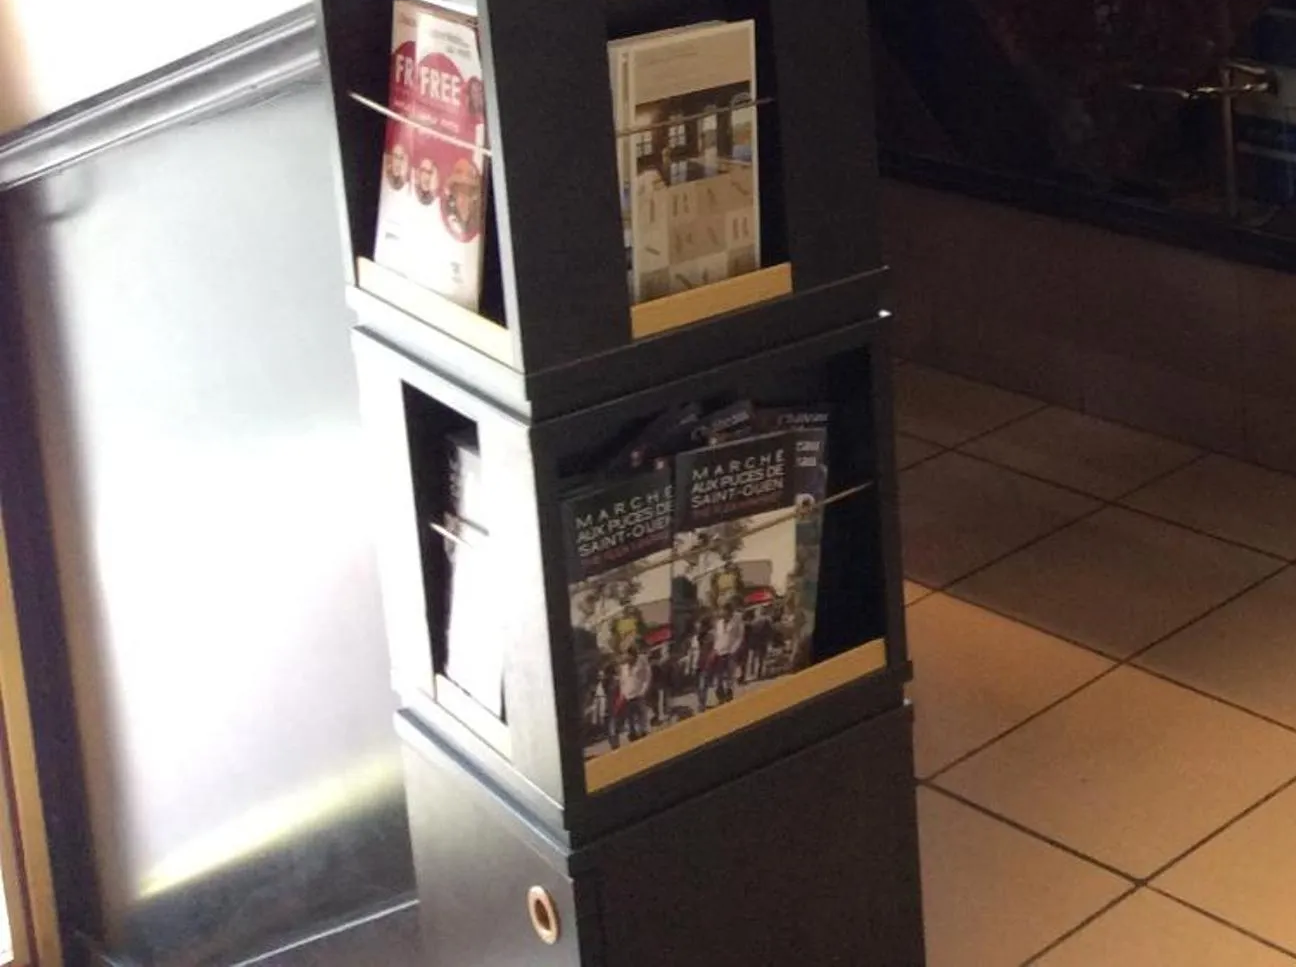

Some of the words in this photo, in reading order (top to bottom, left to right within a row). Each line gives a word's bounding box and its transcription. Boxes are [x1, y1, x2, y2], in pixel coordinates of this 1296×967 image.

[395, 54, 416, 89] FR
[420, 65, 461, 106] FREE
[690, 476, 784, 509] SAINT-OUEN
[691, 478, 719, 495] AUX
[719, 467, 765, 488] PUCES
[766, 463, 786, 478] DE
[576, 523, 605, 544] AUX
[607, 506, 654, 533] PUCES
[655, 499, 675, 516] DE
